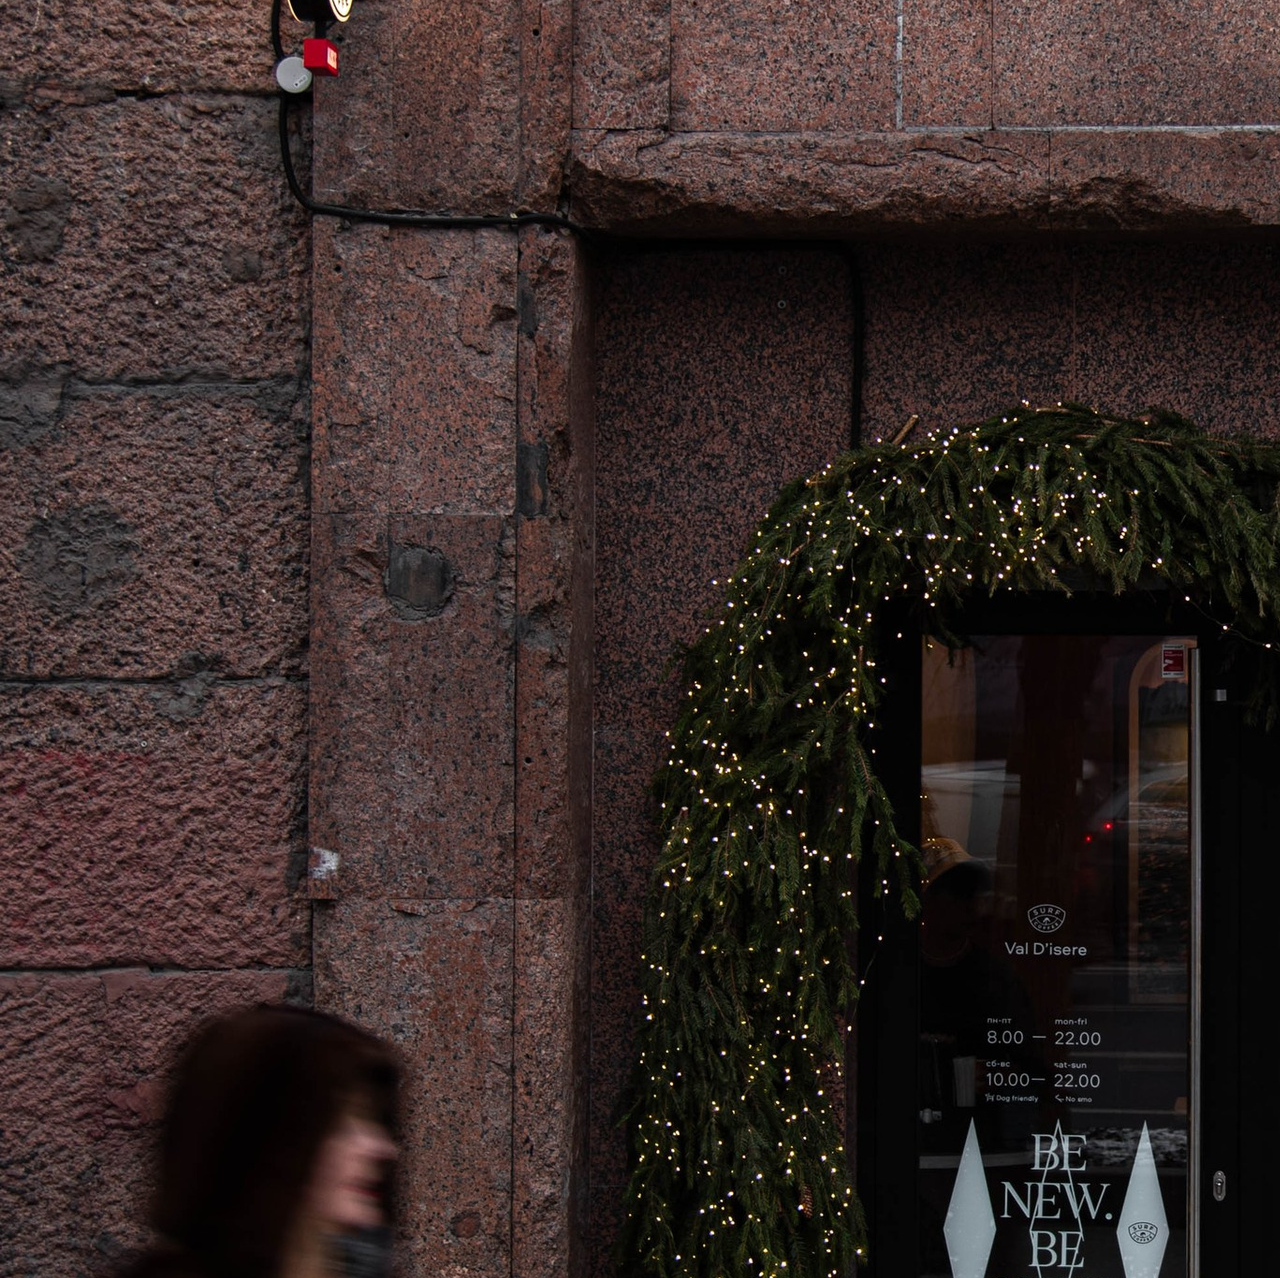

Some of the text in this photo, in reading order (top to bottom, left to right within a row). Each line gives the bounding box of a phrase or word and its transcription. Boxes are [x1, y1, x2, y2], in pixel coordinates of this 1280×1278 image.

[1032, 907, 1061, 916] SURF
[1004, 942, 1087, 956] Val D'isere
[987, 1030, 1024, 1045] 8.00
[1054, 1031, 1101, 1046] 22.00
[985, 1059, 1011, 1068] сб-вс
[1053, 1061, 1087, 1069] sat-sun
[986, 1072, 1030, 1087] 10.00
[1054, 1073, 1101, 1088] 22.00
[996, 1094, 1039, 1103] Dog friendly
[1031, 1133, 1087, 1171] BE
[1000, 1181, 1113, 1220] NEW.
[1028, 1230, 1085, 1268] BE
